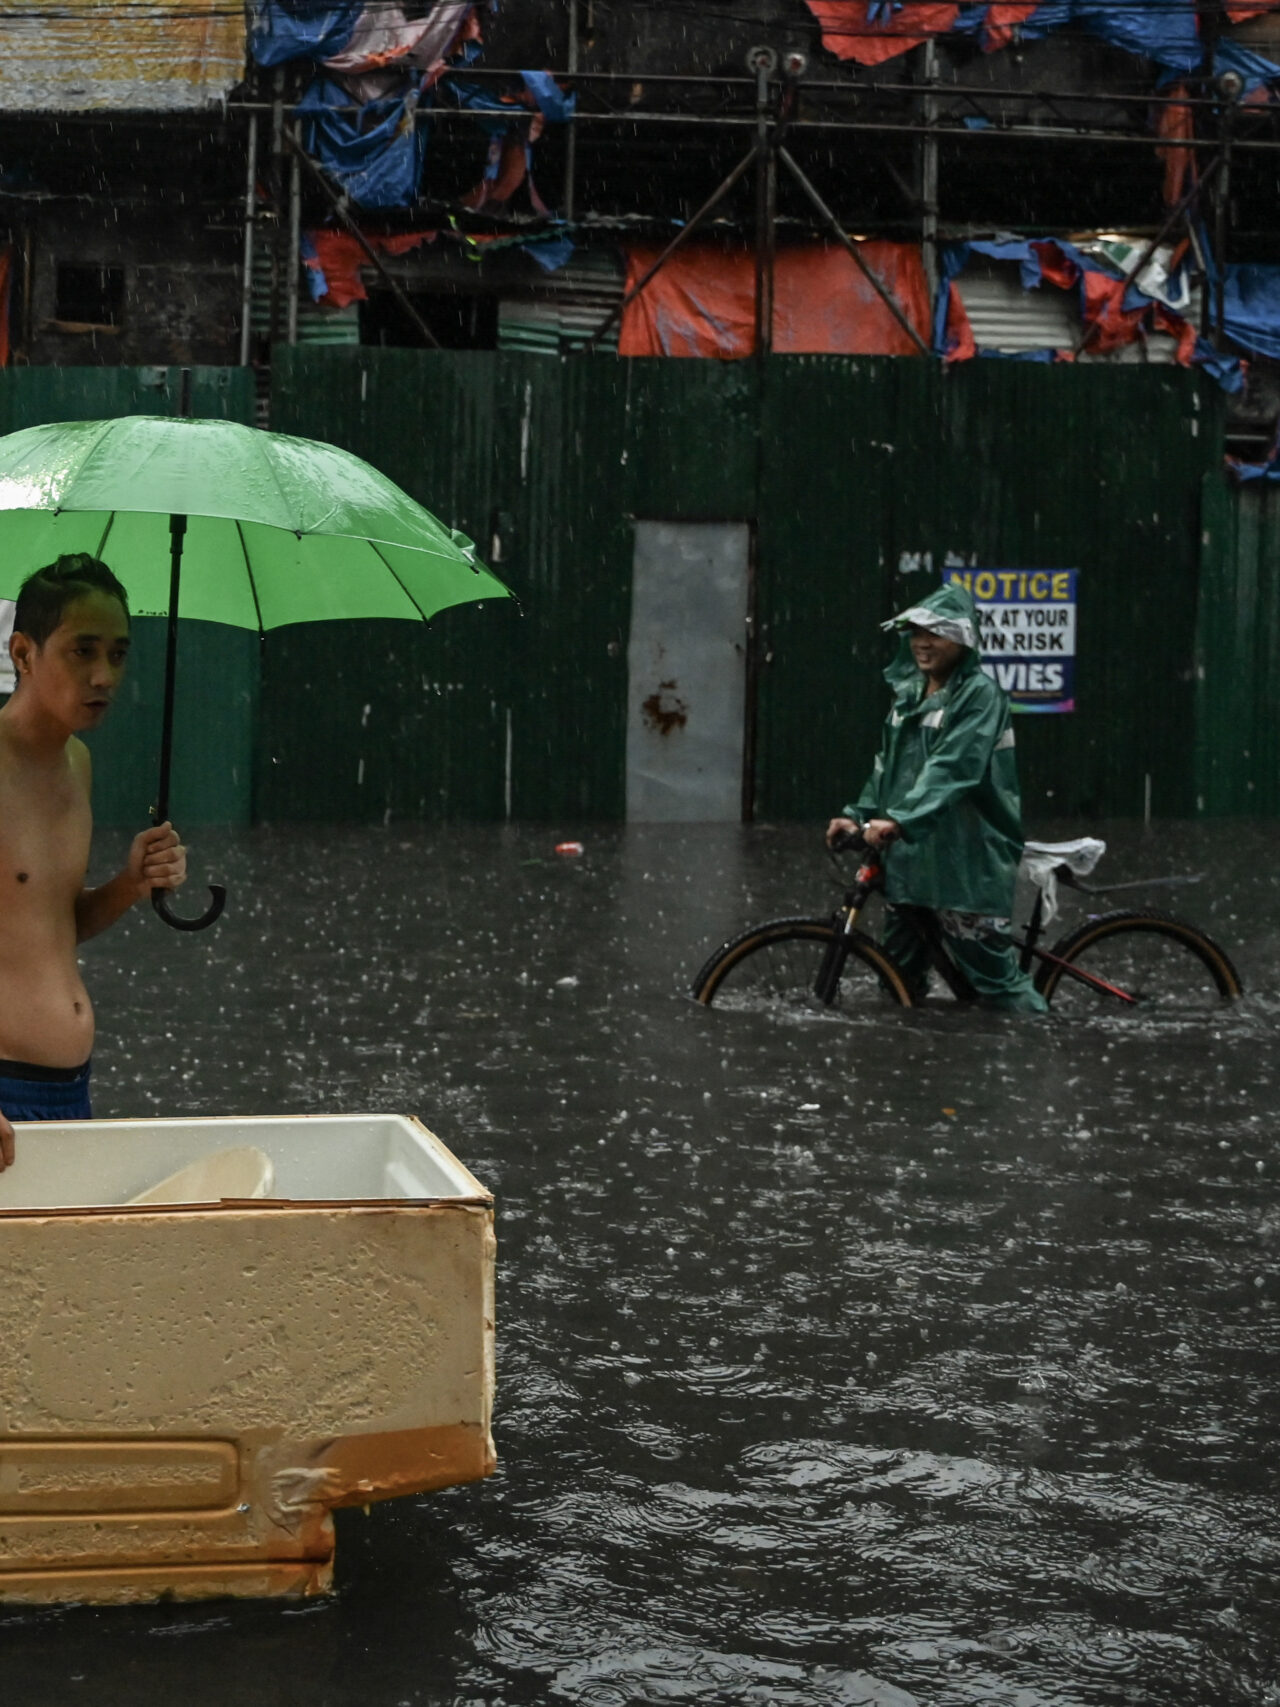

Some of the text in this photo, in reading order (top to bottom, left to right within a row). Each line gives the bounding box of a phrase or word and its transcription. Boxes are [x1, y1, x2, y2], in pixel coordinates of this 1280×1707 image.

[951, 572, 1070, 600] NOTICE
[1001, 609, 1019, 627] AT
[1025, 609, 1068, 627] YOUR
[1013, 633, 1064, 651] RISK
